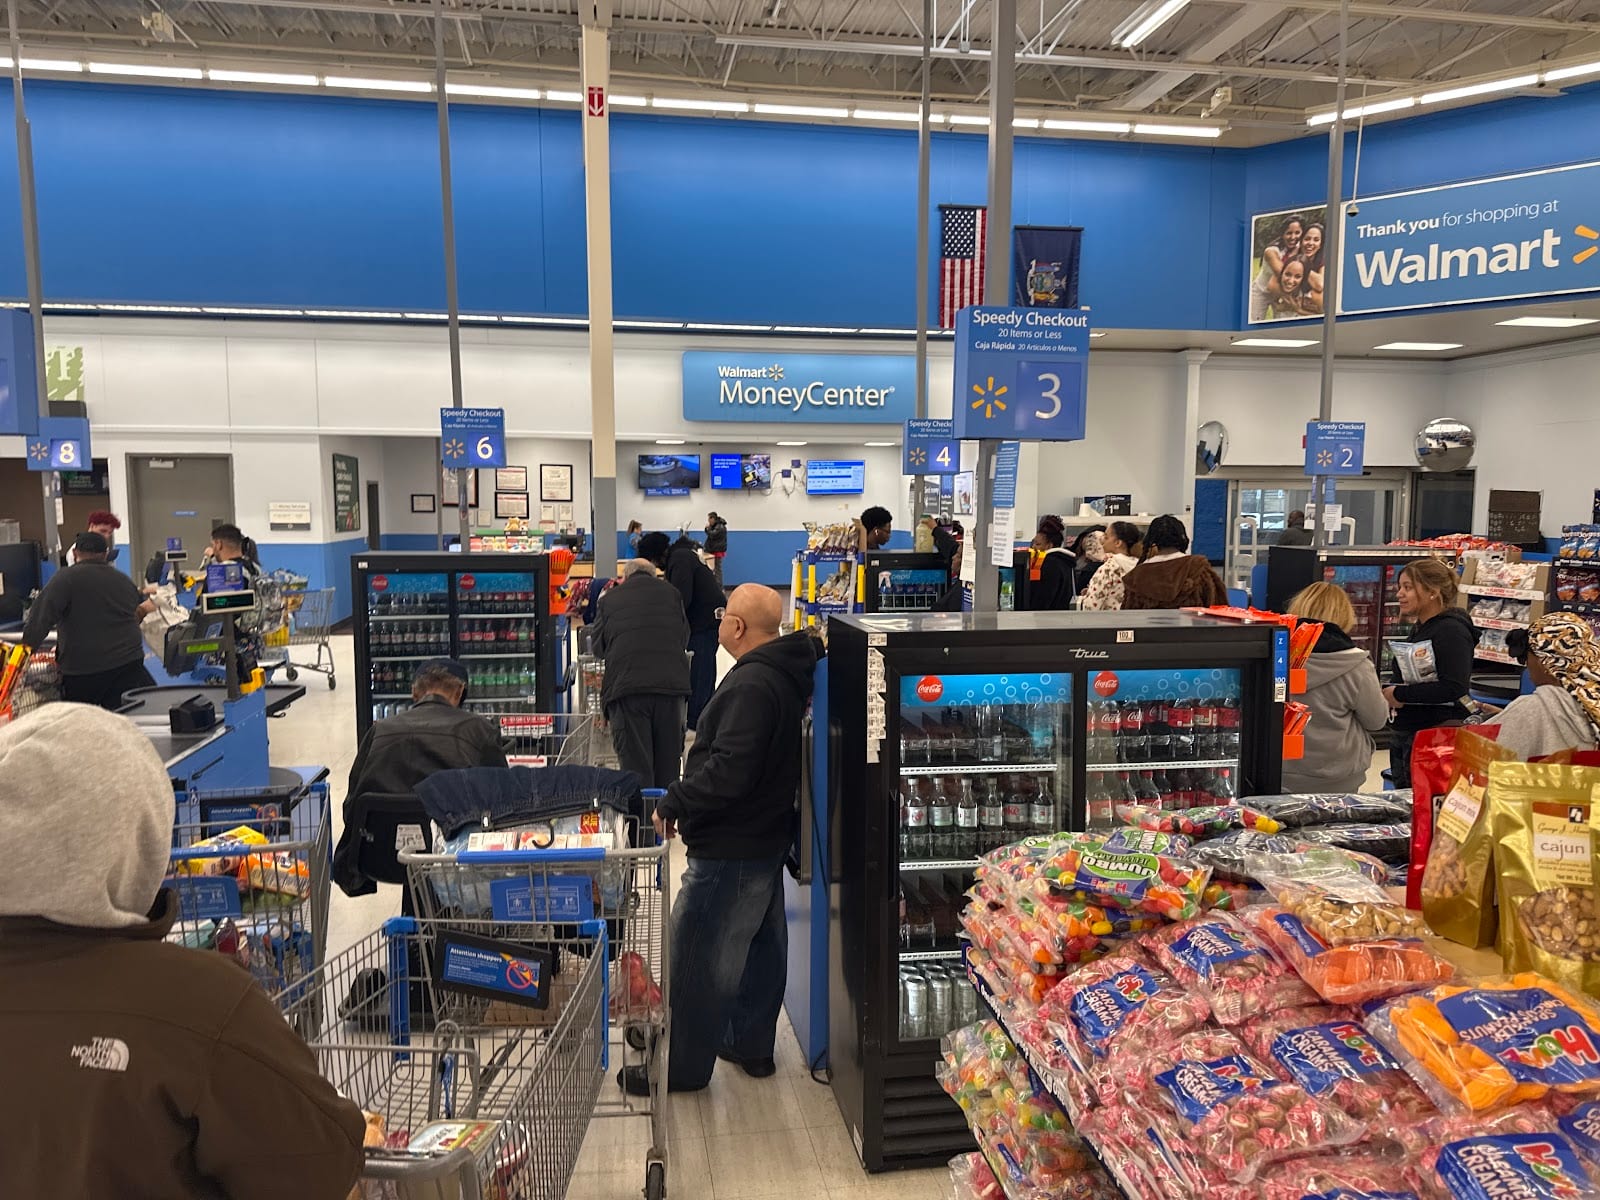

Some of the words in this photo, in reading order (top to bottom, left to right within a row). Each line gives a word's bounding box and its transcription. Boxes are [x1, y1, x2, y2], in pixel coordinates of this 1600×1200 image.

[1357, 220, 1406, 239] Thank
[1408, 216, 1440, 236] you
[1442, 211, 1464, 227] for
[1465, 201, 1540, 225] shopping
[1542, 199, 1559, 213] at
[1355, 228, 1561, 289] Walmart
[973, 309, 1023, 327] Speedy
[1026, 311, 1088, 328] Checkout
[998, 328, 1009, 338] 20
[1010, 329, 1033, 339] Items
[1034, 331, 1043, 339] or
[1044, 330, 1062, 340] Less
[975, 341, 991, 351] Caja
[1018, 343, 1026, 351] 20
[1058, 345, 1078, 353] Menos
[718, 365, 767, 379] Walmart
[1035, 373, 1062, 419] 3
[442, 409, 468, 418] Speedy
[469, 409, 501, 417] Checkout
[909, 420, 931, 428] Speedy
[1317, 423, 1338, 431] Speedy
[59, 442, 75, 464] 8
[476, 436, 493, 460] 6
[936, 446, 951, 467] 4
[1341, 448, 1353, 468] 2
[1070, 647, 1110, 659] true
[917, 683, 942, 694] Coca-Cola
[1094, 679, 1118, 689] Coca-Cola
[1541, 839, 1585, 861] cajun
[1083, 855, 1157, 878] JUMBO
[450, 947, 477, 958] Attention
[477, 951, 503, 963] shoppers
[1084, 990, 1117, 1027] CREAMS
[92, 1036, 113, 1049] THE
[1330, 1024, 1382, 1067] HOME
[1498, 1025, 1600, 1070] HOME
[71, 1045, 111, 1060] NORTH
[1290, 1034, 1336, 1073] CREAMS
[79, 1057, 107, 1069] FACE
